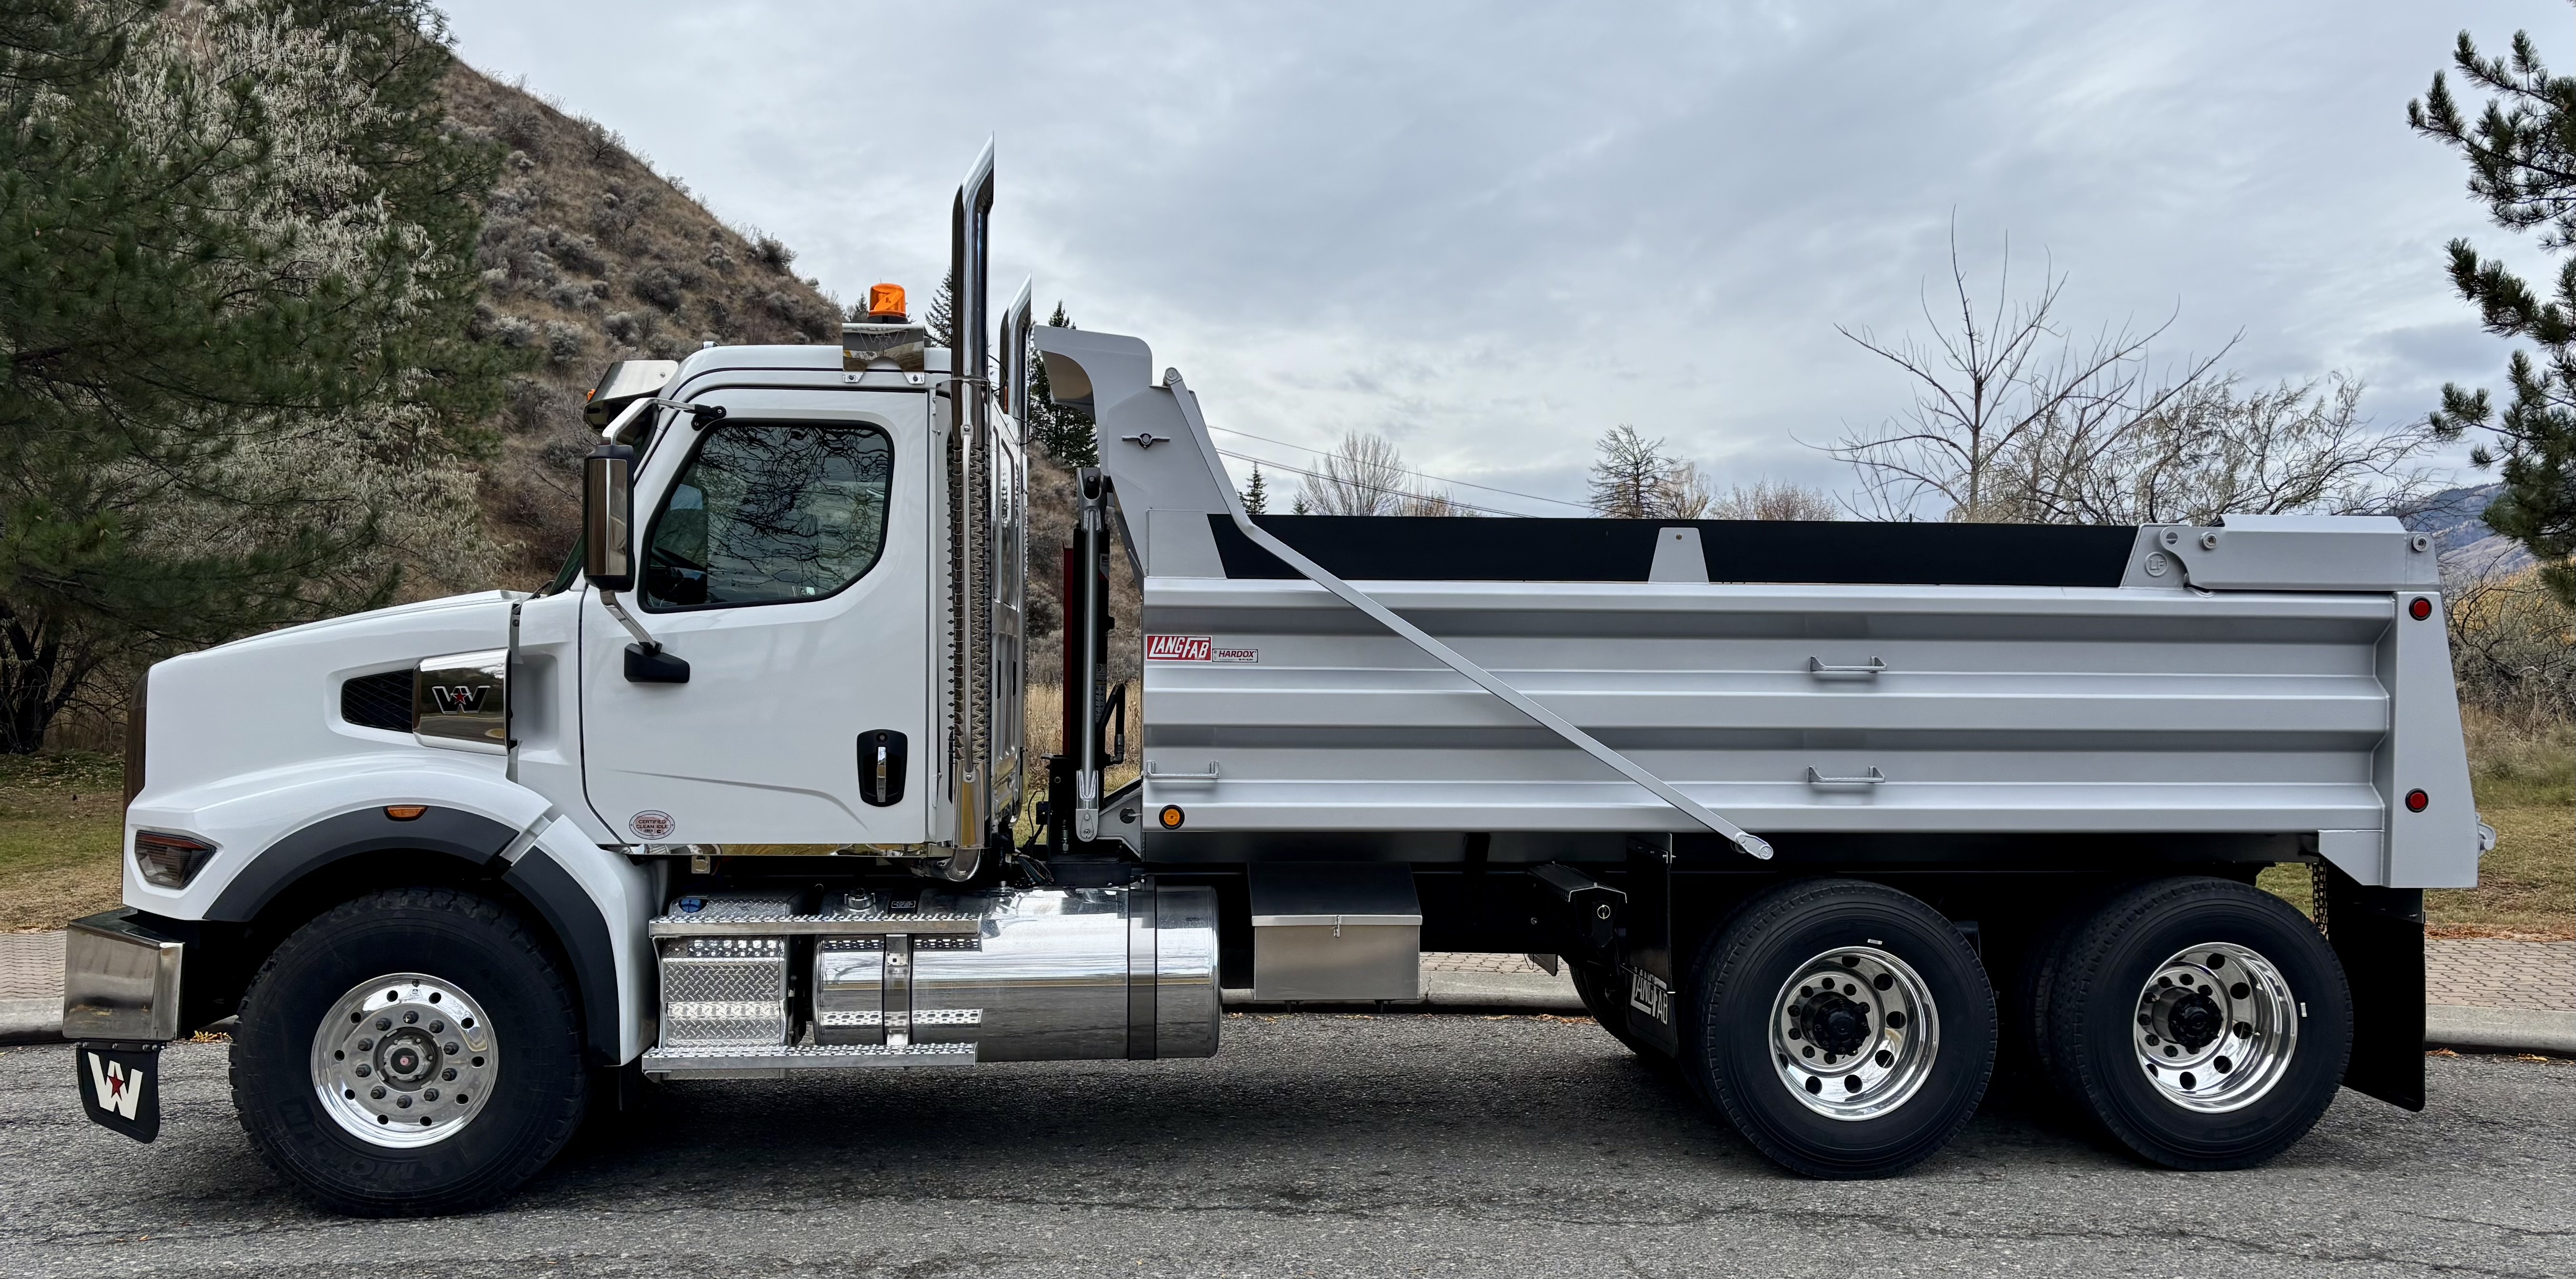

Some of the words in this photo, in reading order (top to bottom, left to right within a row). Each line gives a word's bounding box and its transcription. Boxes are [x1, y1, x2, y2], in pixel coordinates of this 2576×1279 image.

[2149, 558, 2165, 570] LF
[432, 685, 491, 714] W
[88, 1052, 143, 1121] W
